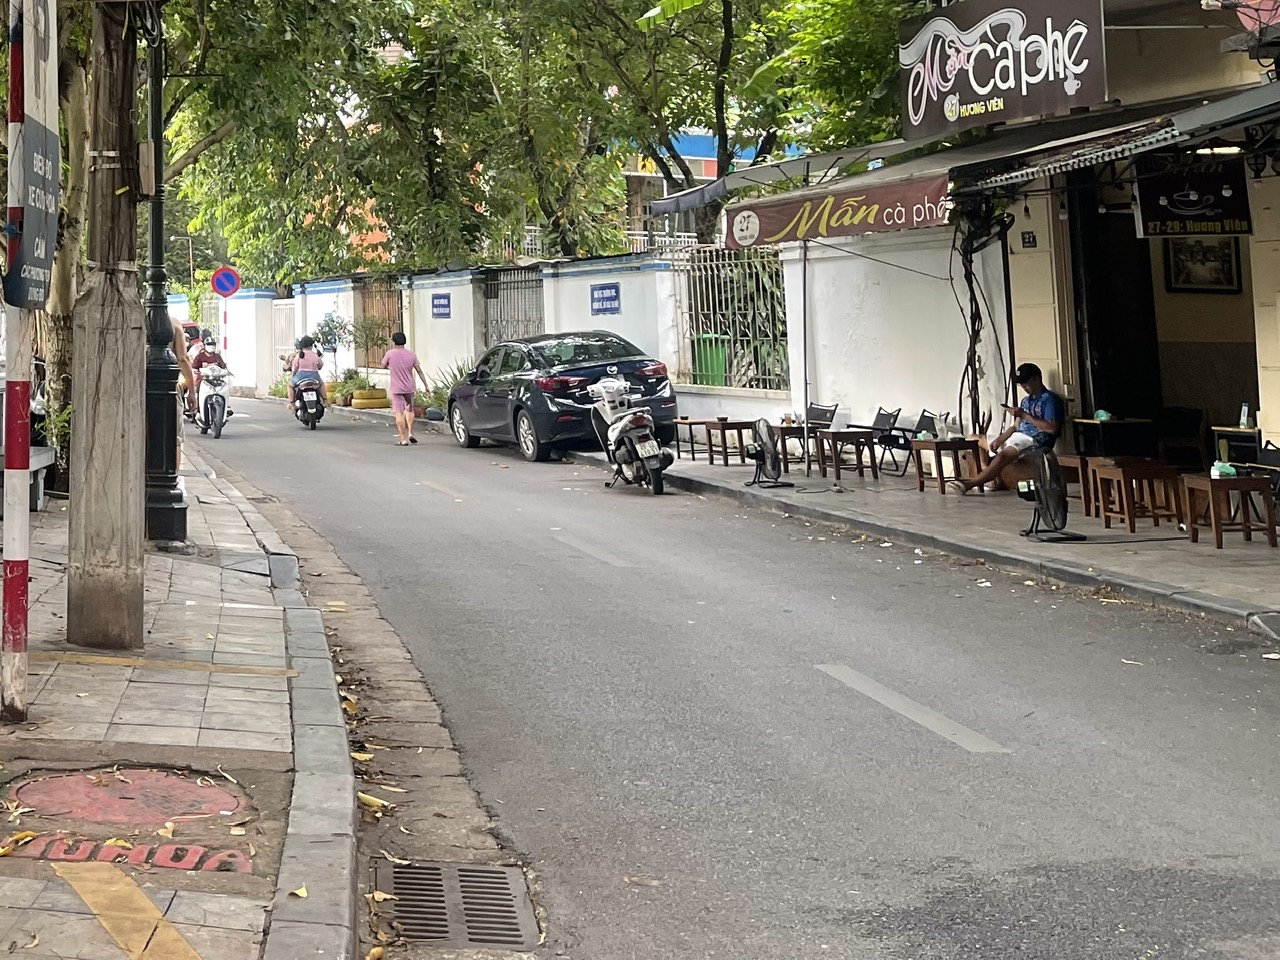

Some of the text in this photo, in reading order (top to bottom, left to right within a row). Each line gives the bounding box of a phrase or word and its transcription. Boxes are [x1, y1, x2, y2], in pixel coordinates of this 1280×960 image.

[28, 184, 36, 207] XE
[739, 214, 752, 232] 27
[764, 194, 880, 242] Mẫn
